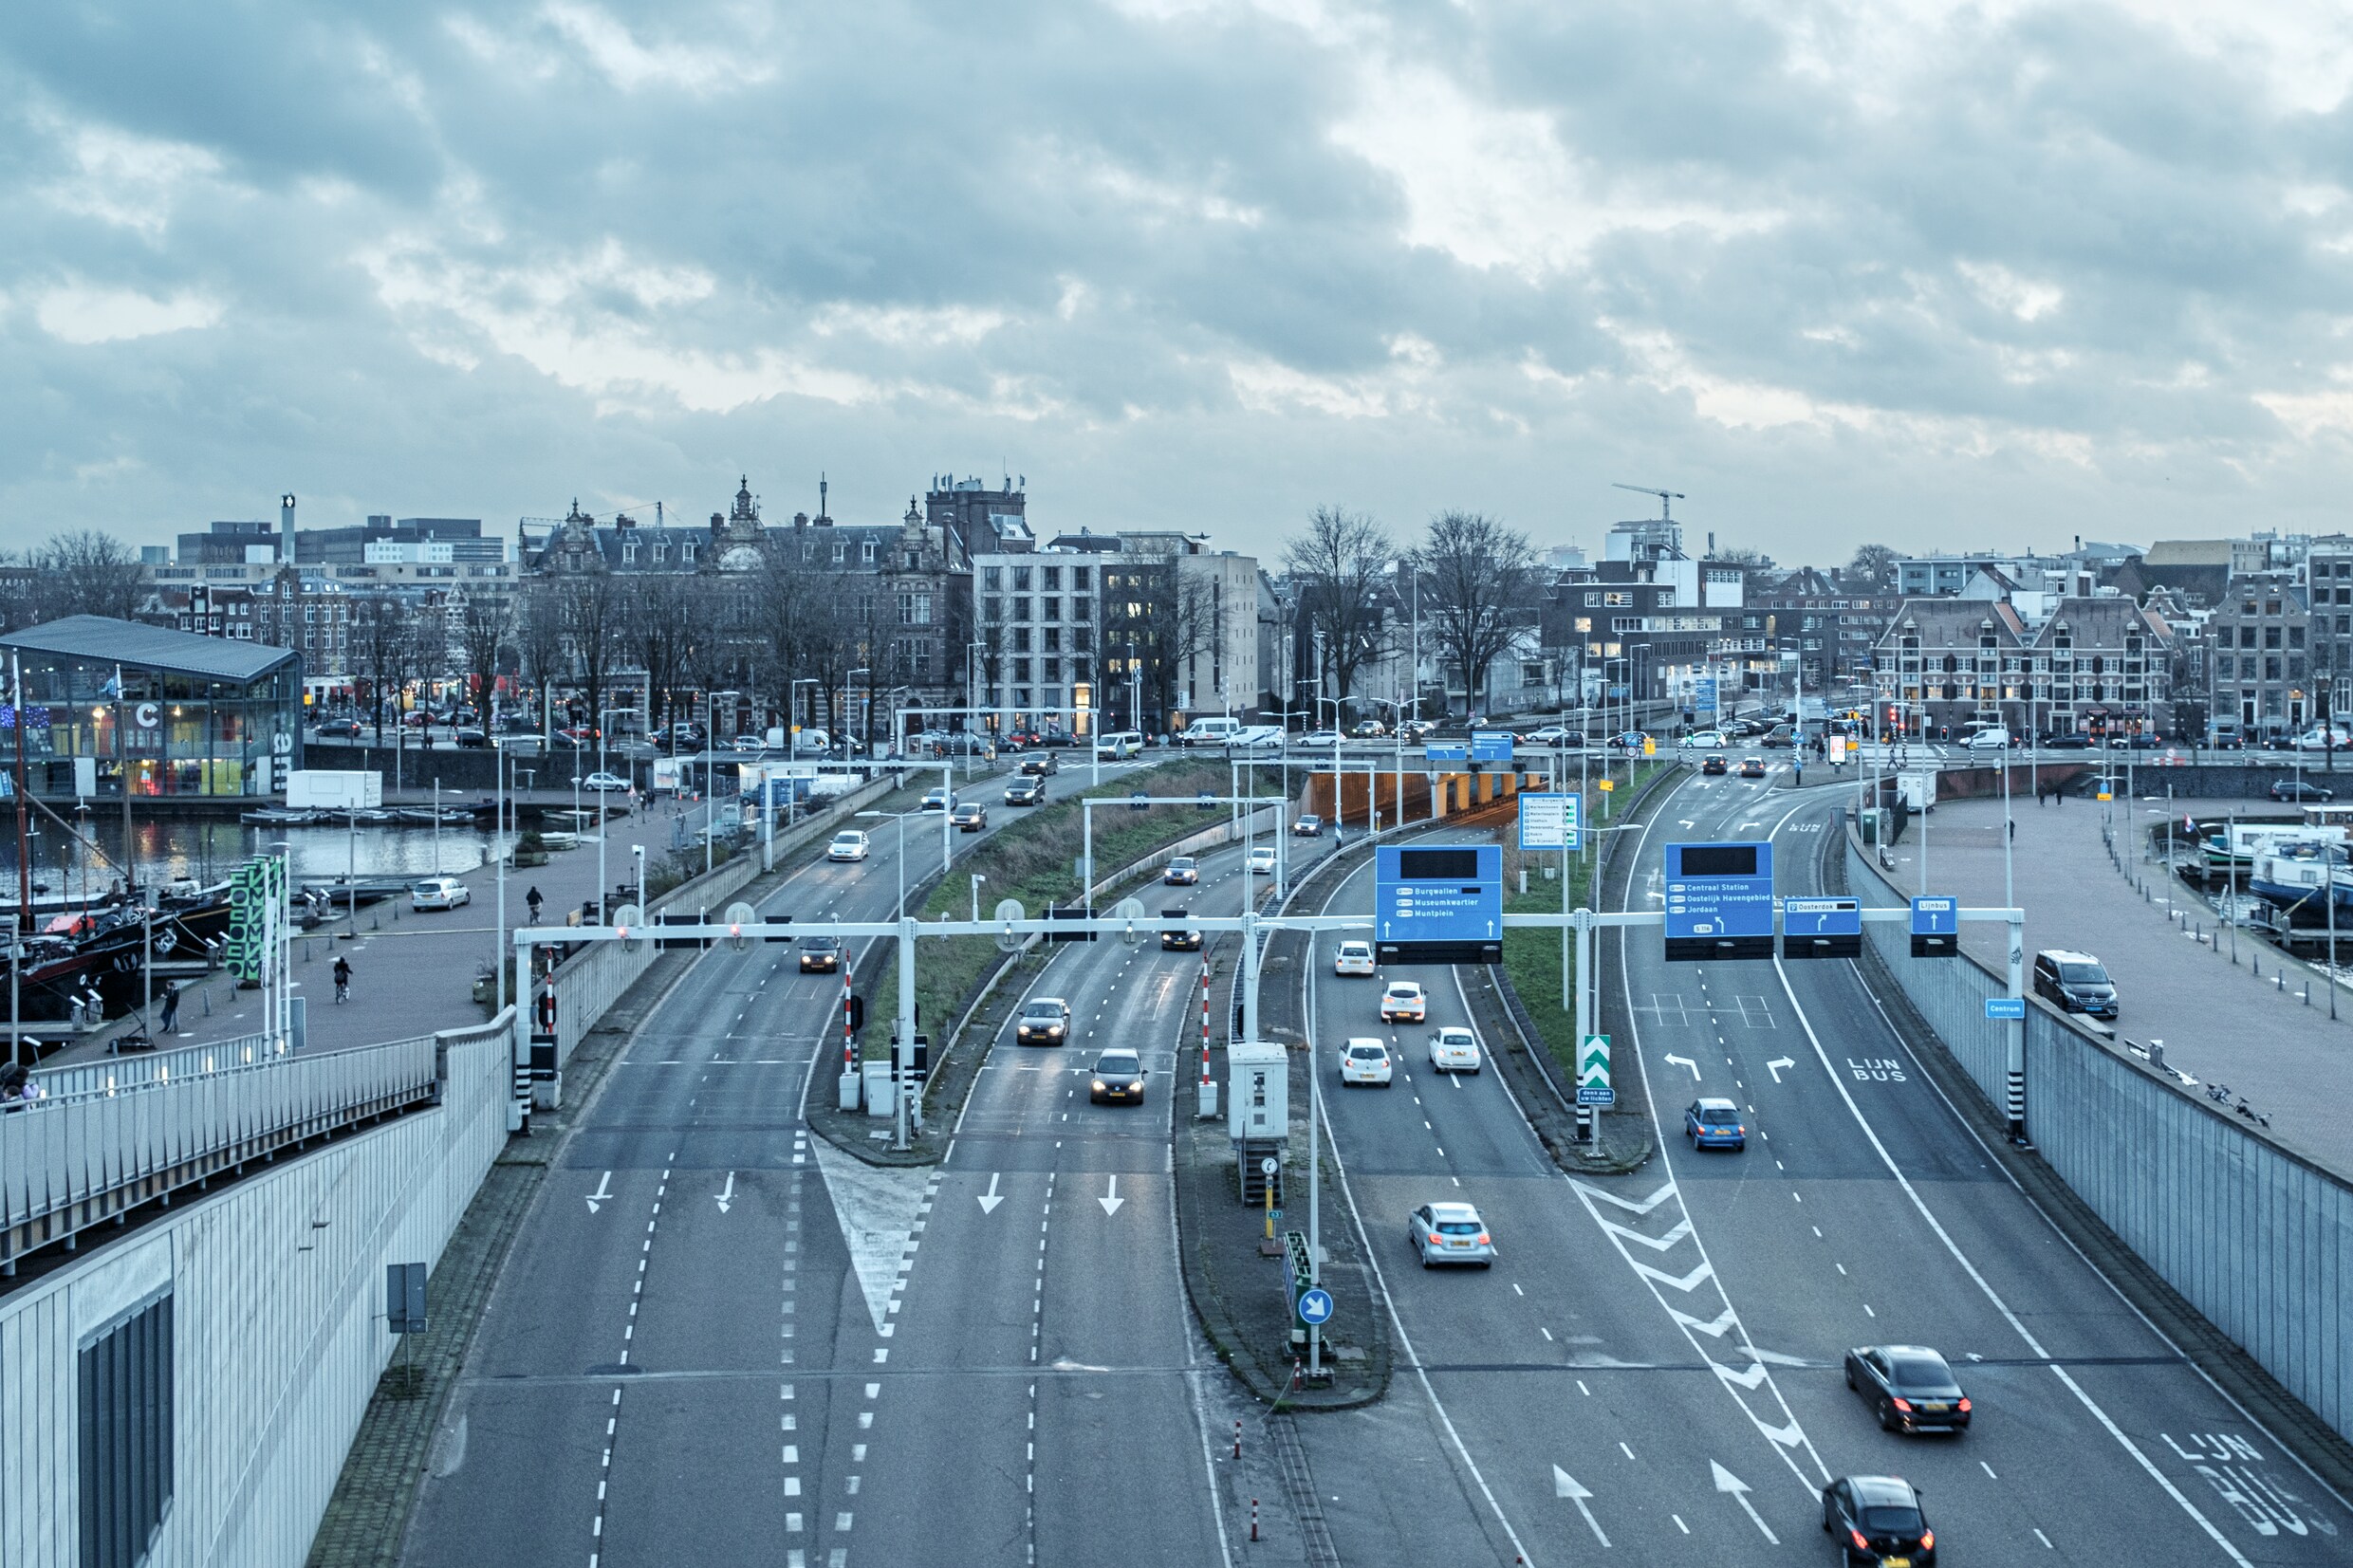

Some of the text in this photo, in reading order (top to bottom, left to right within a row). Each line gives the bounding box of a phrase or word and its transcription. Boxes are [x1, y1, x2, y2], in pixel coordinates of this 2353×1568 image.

[1415, 888, 1458, 896] Burgwallen
[1687, 895, 1720, 903] Oostelijk
[1846, 1058, 1900, 1070] LIJN
[1853, 1070, 1907, 1081] BUS
[2160, 1433, 2266, 1461] LIJN
[2193, 1466, 2339, 1536] BUS
